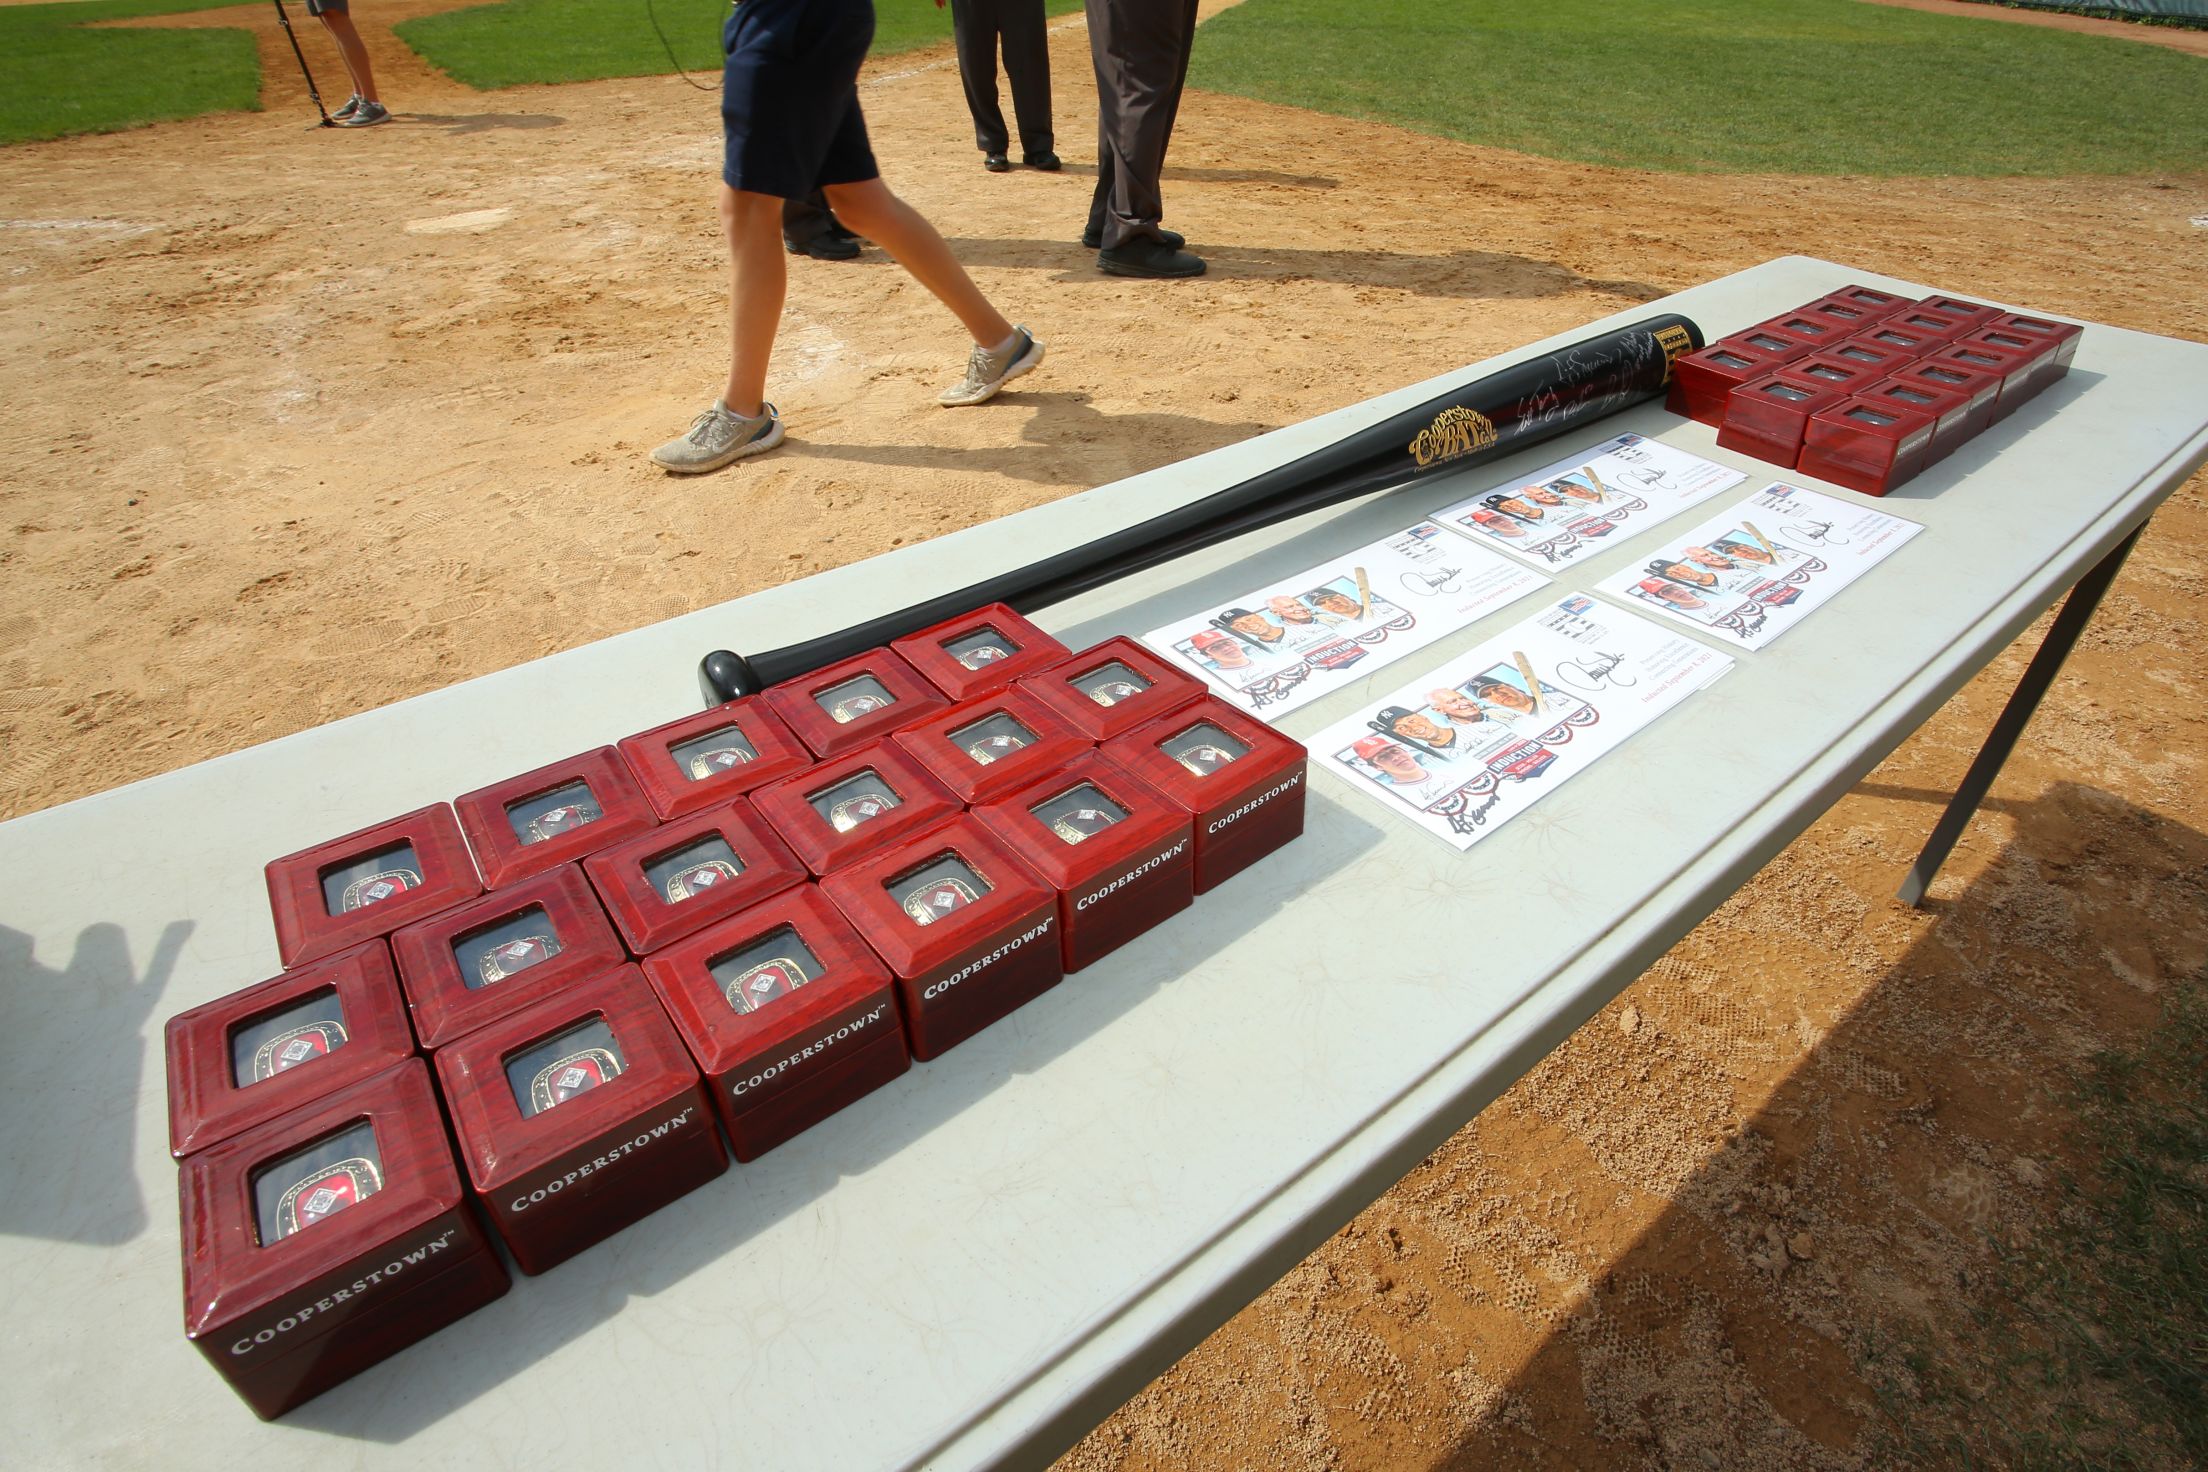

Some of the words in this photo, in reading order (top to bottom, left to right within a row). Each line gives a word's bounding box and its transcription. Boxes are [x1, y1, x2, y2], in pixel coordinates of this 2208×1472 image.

[1409, 404, 1498, 466] Cooperstown
[1435, 421, 1480, 458] BAT
[1489, 741, 1541, 773] INDUCTION
